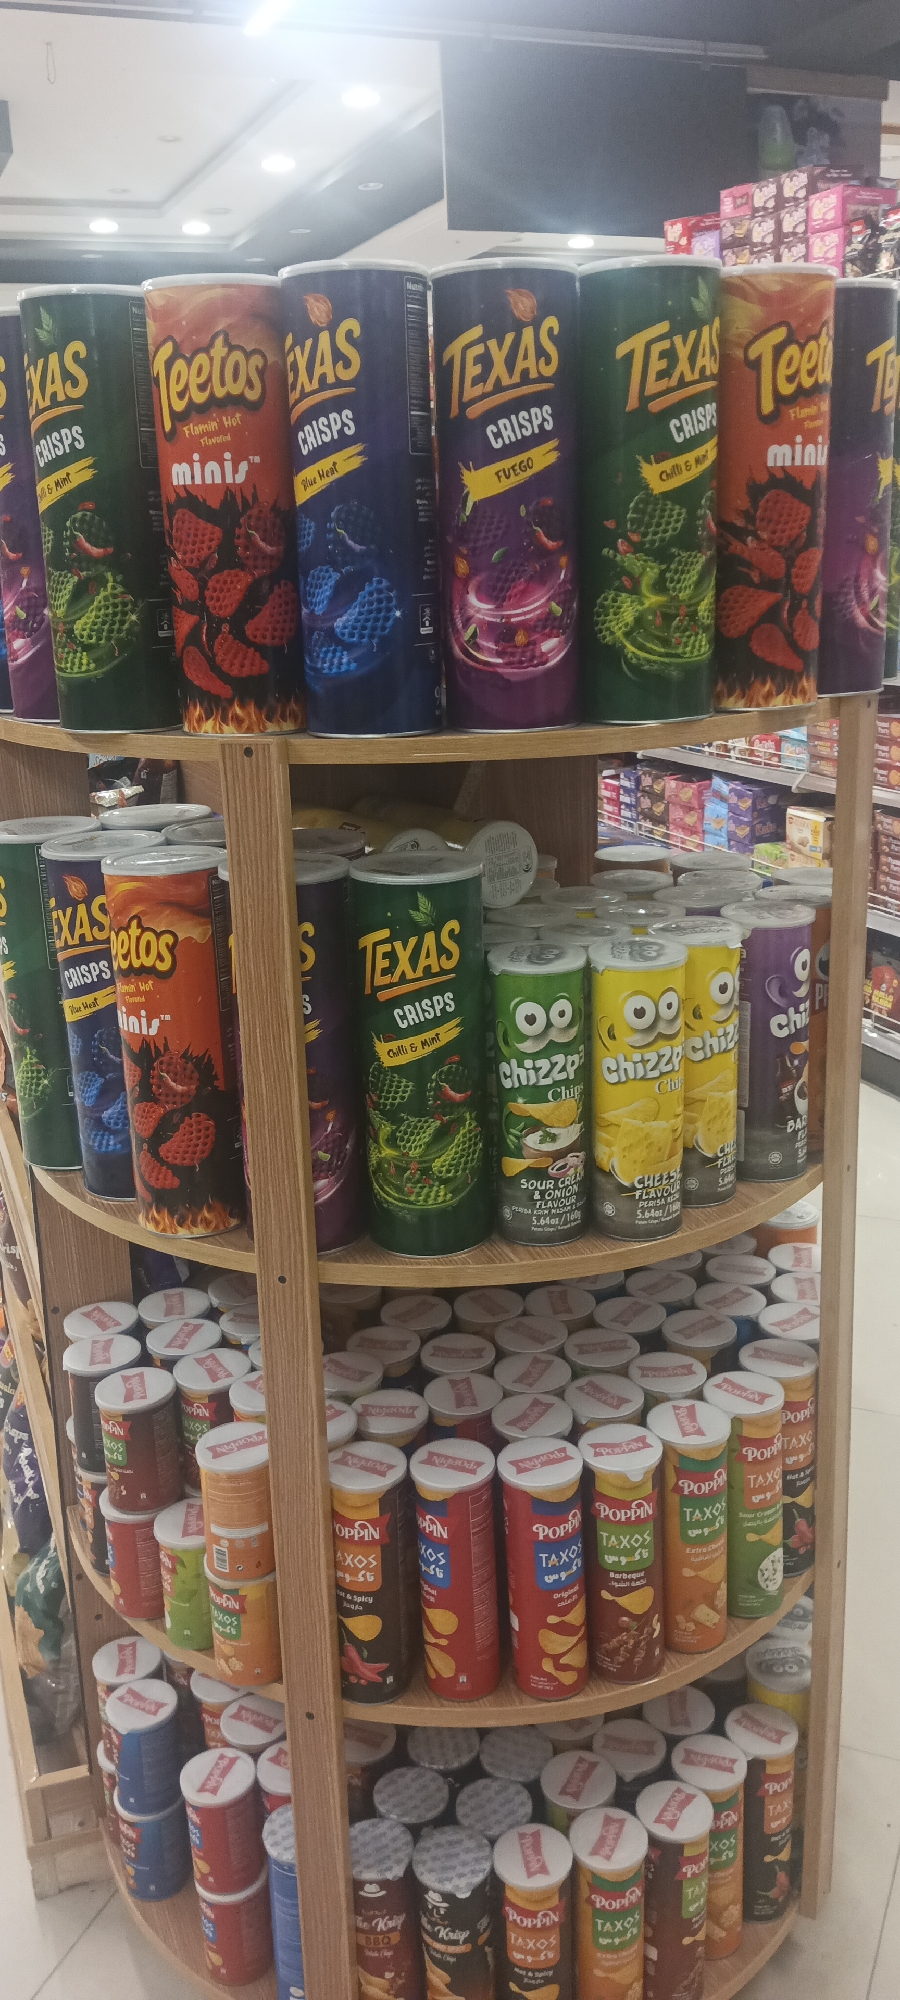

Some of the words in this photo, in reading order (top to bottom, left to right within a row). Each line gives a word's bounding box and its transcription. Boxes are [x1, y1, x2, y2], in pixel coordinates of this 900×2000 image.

[285, 317, 361, 408] EXAS
[443, 315, 559, 419] TEXAS
[615, 316, 720, 413] TEXAS
[24, 341, 89, 421] XAS
[153, 334, 263, 432] Teetos
[222, 413, 242, 428] Hot
[297, 408, 356, 456] CRISPS
[485, 404, 554, 449] CRISPS
[669, 402, 717, 443] CRISPS
[35, 425, 86, 467] CRISPS
[301, 473, 318, 492] Blue
[318, 460, 339, 482] Heat
[494, 456, 534, 483] FUEGO
[659, 462, 683, 482] Chilli
[684, 460, 692, 472] &
[54, 472, 72, 492] Mint
[358, 919, 461, 995] TEXAS
[63, 960, 112, 990] CRISPS
[140, 979, 154, 991] Hot
[82, 996, 100, 1011] Heat
[393, 991, 456, 1029] CRISPS
[386, 1042, 407, 1059] Chilli
[408, 1043, 418, 1053] &
[420, 1032, 442, 1050] Mint
[547, 1082, 584, 1103] Chips
[520, 1178, 555, 1190] SOUR
[533, 1190, 541, 1200] &
[544, 1184, 579, 1200] ONION
[635, 1180, 681, 1200] FLAVOUR
[536, 1195, 577, 1209] FLAVOUR
[596, 1440, 644, 1456] POPPIN
[595, 1499, 653, 1522] POPPIN
[334, 1520, 380, 1542] OPPIN
[599, 1529, 652, 1549] TAXOS
[335, 1550, 378, 1569] AXOS
[538, 1538, 582, 1568] TAXOS
[609, 1570, 645, 1580] Barbeque
[353, 1594, 374, 1604] Spicy
[553, 1583, 579, 1600] Original
[504, 1906, 560, 1929] POPPIN
[595, 1910, 640, 1933] TAXOS
[509, 1931, 557, 1950] TAXOS
